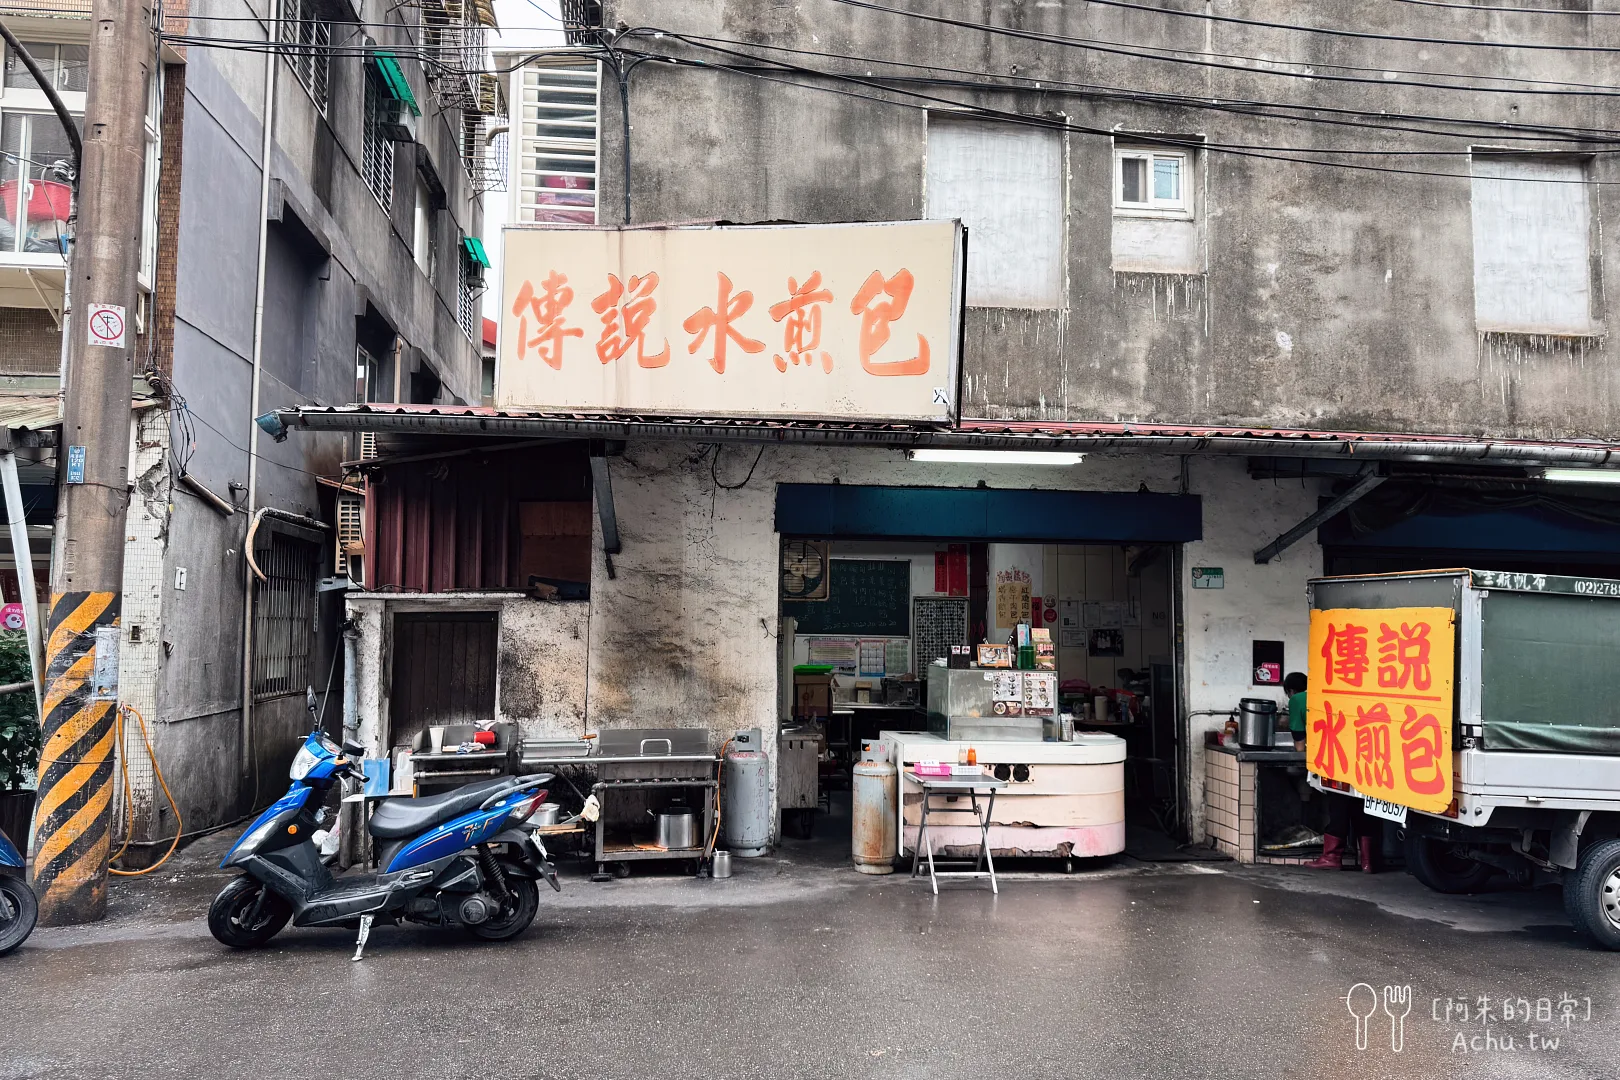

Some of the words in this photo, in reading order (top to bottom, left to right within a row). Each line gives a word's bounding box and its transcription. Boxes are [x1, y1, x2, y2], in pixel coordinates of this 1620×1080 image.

[512, 268, 930, 377] 傳說水煎包
[1321, 622, 1432, 691] 傳說
[1313, 700, 1446, 795] 水煎包
